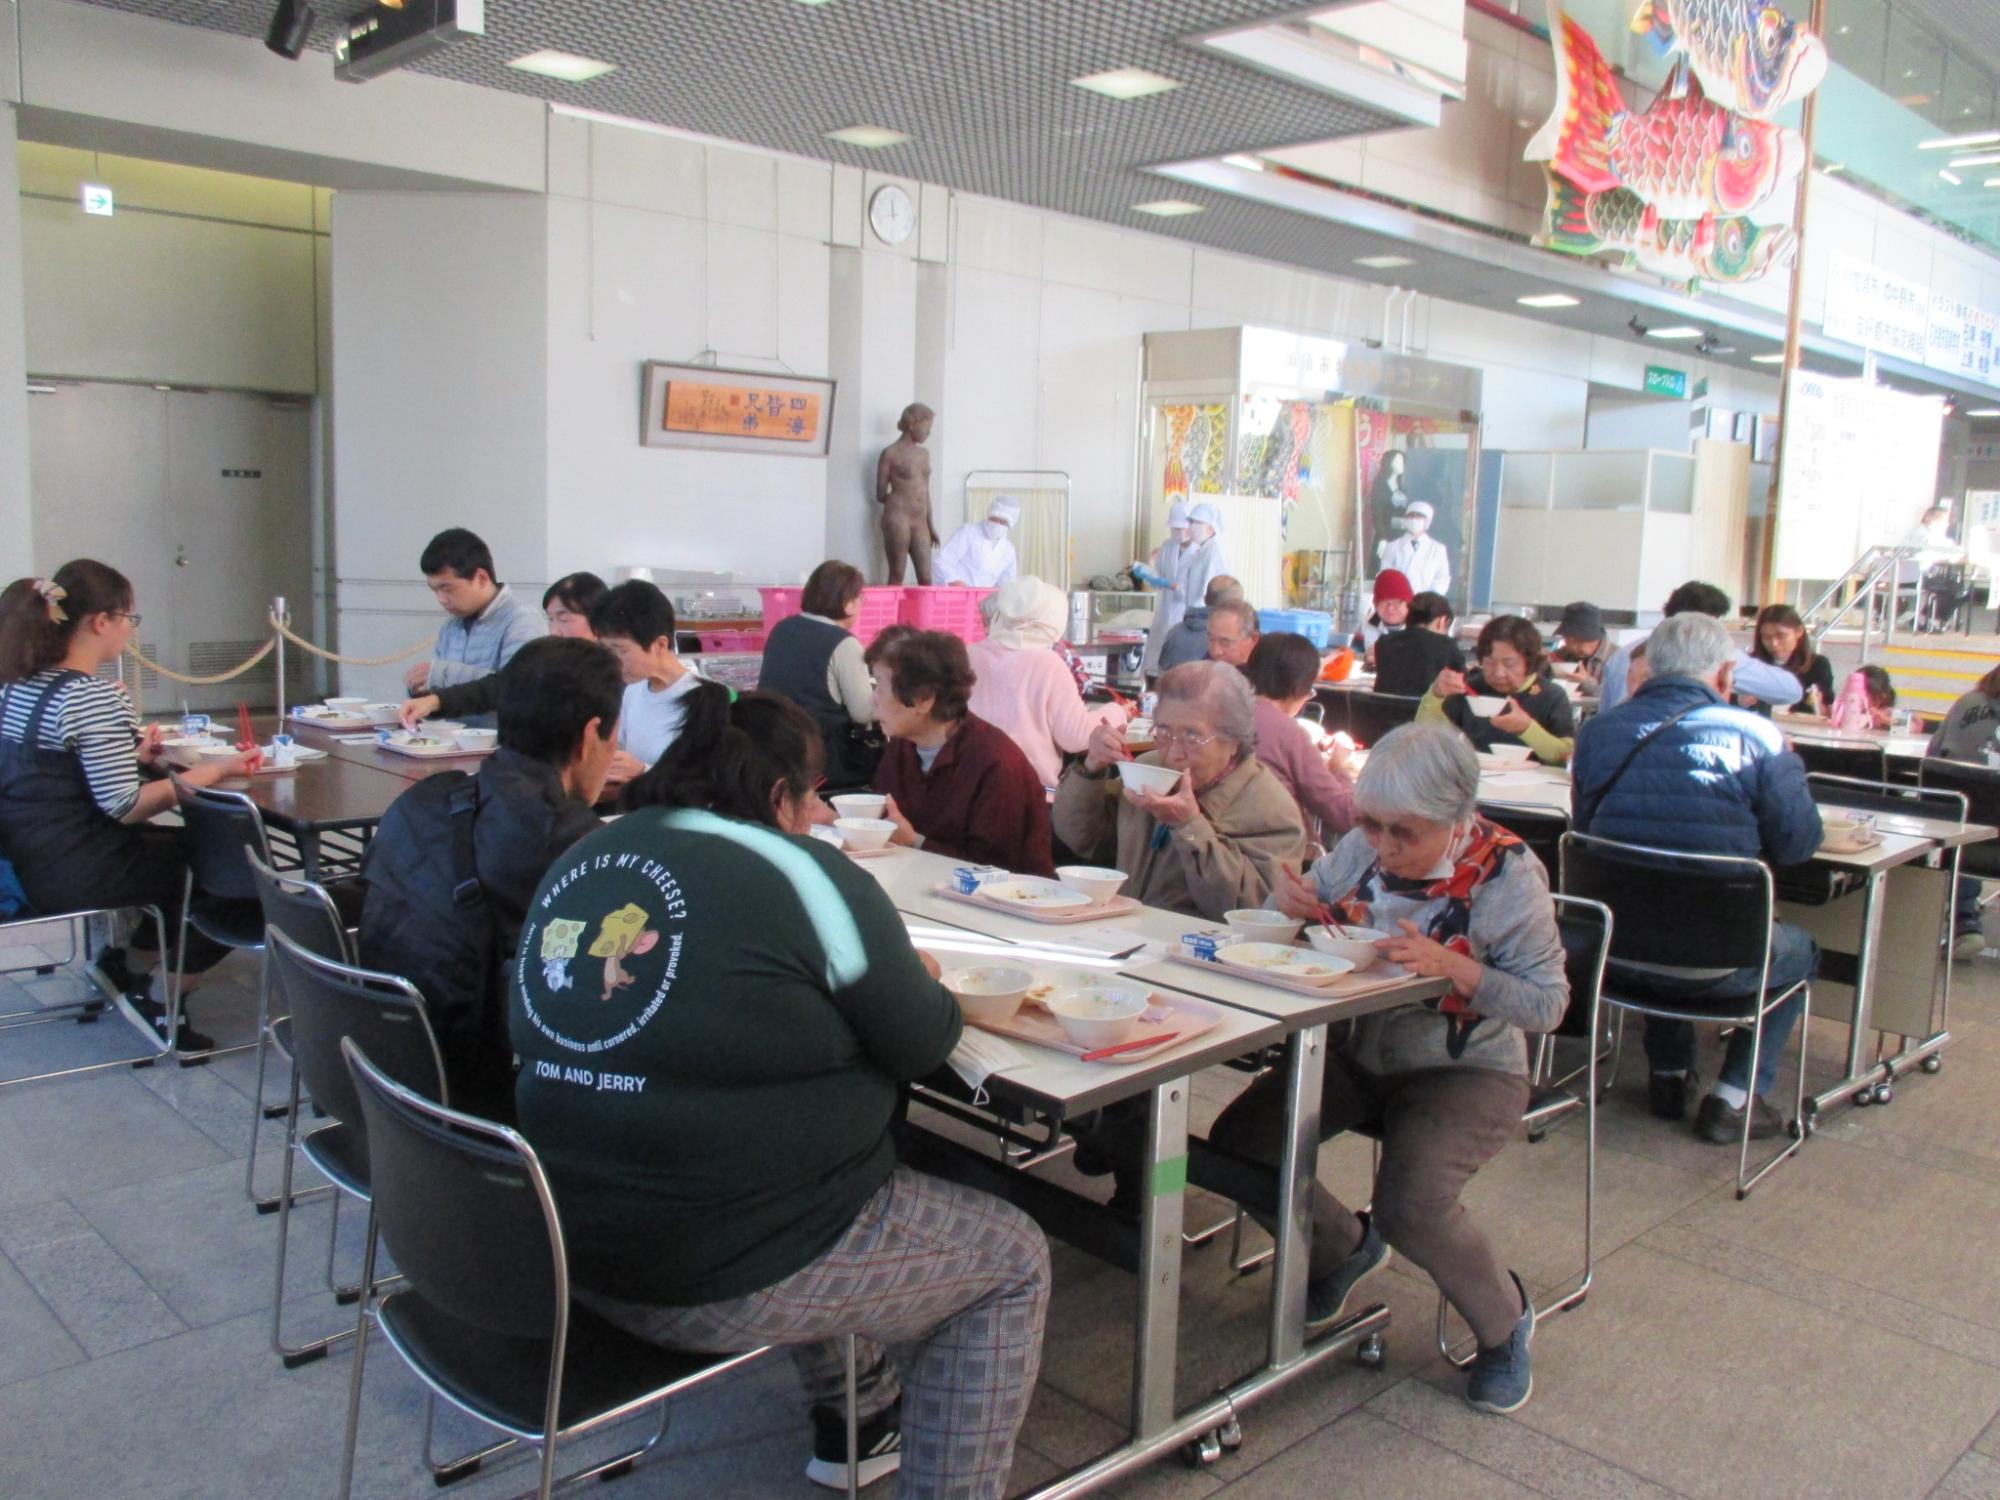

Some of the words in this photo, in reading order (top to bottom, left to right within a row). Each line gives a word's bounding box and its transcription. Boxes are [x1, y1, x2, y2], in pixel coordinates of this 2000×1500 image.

[541, 860, 588, 908] WHERE
[594, 853, 611, 870] IS
[615, 852, 641, 869] MY
[641, 859, 687, 919] CHEESE?
[665, 931, 684, 979] provoked.
[660, 978, 672, 991] or
[636, 989, 666, 1027] irritated
[531, 1011, 542, 1028] his
[540, 1023, 555, 1040] own
[555, 1031, 586, 1053] business
[586, 1039, 604, 1053] until
[535, 1060, 561, 1080] TOM
[563, 1066, 594, 1087] AND
[596, 1072, 647, 1093] JERRY
